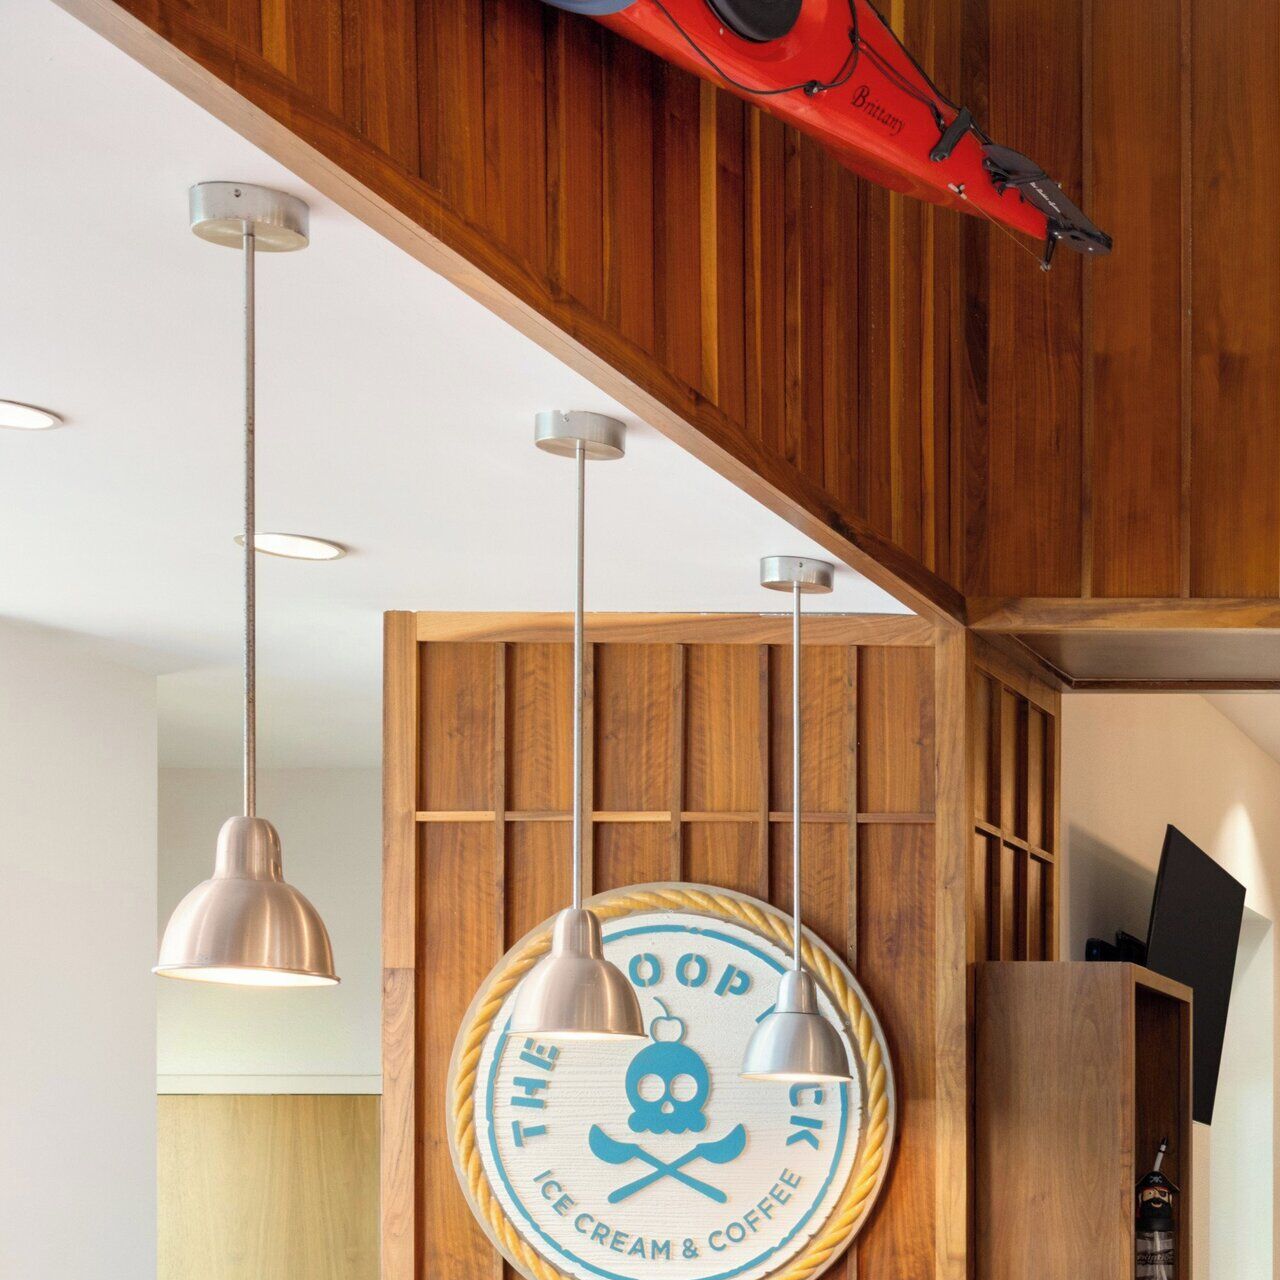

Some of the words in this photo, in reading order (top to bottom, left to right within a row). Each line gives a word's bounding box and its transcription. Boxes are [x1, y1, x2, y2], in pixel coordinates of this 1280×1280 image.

[851, 85, 904, 137] Brittany
[510, 1038, 560, 1148] THE
[628, 952, 752, 997] OOP
[533, 1169, 576, 1216] ICE
[573, 1206, 671, 1260] CREAM
[682, 1239, 700, 1259] &
[707, 1166, 803, 1252] COFFEE
